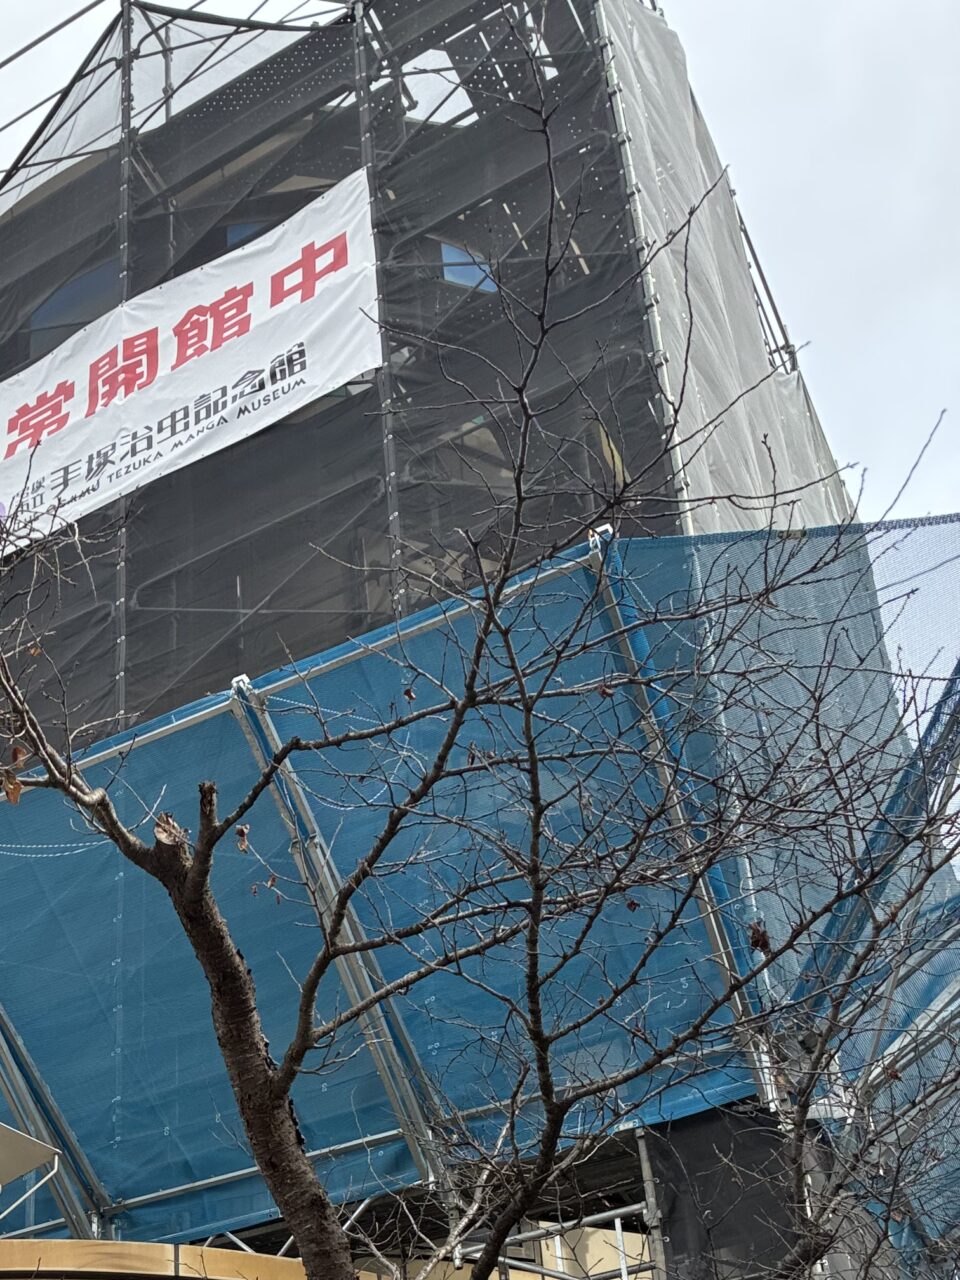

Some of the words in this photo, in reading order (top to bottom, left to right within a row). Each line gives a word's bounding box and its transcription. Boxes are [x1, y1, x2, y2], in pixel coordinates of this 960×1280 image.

[107, 451, 163, 483] TEZUKA
[171, 415, 228, 452] MANGA
[235, 377, 307, 420] MUSEUM
